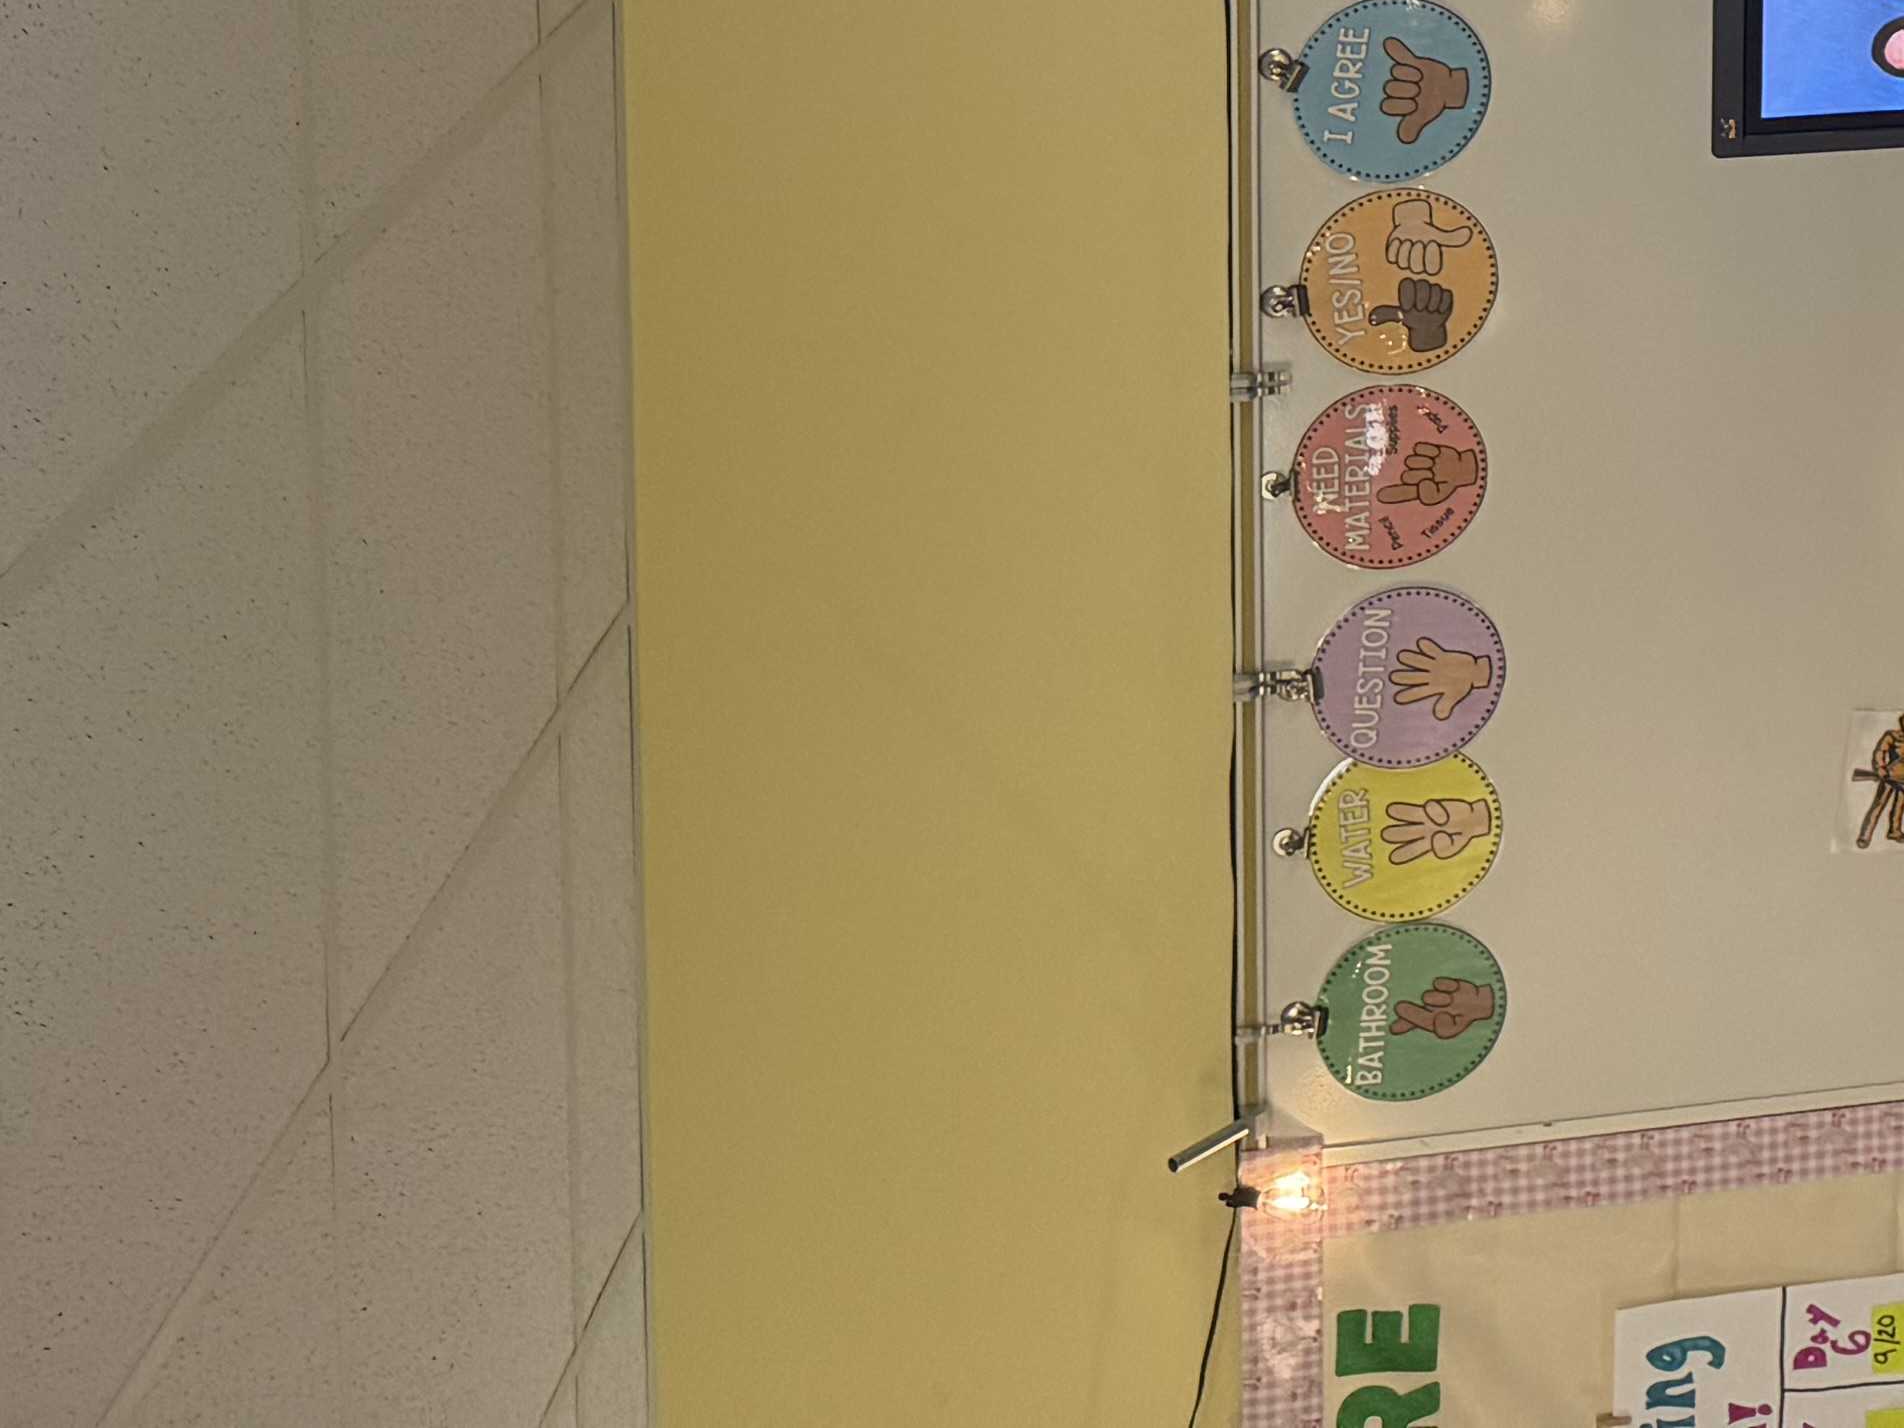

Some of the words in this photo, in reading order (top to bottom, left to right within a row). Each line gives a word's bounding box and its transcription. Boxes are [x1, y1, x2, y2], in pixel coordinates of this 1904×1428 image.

[1330, 27, 1371, 122] AGREE
[1323, 131, 1354, 144] I
[1325, 233, 1368, 345] YES/NO
[1311, 447, 1340, 514] NEED
[1344, 403, 1371, 551] MATERIALS
[1350, 609, 1393, 748] QUESTION
[1337, 788, 1374, 888] WATER
[1357, 943, 1394, 1086] BATHROOM
[1792, 1304, 1841, 1371] Day
[1830, 1330, 1871, 1355] 6
[1873, 1315, 1901, 1364] 9/20
